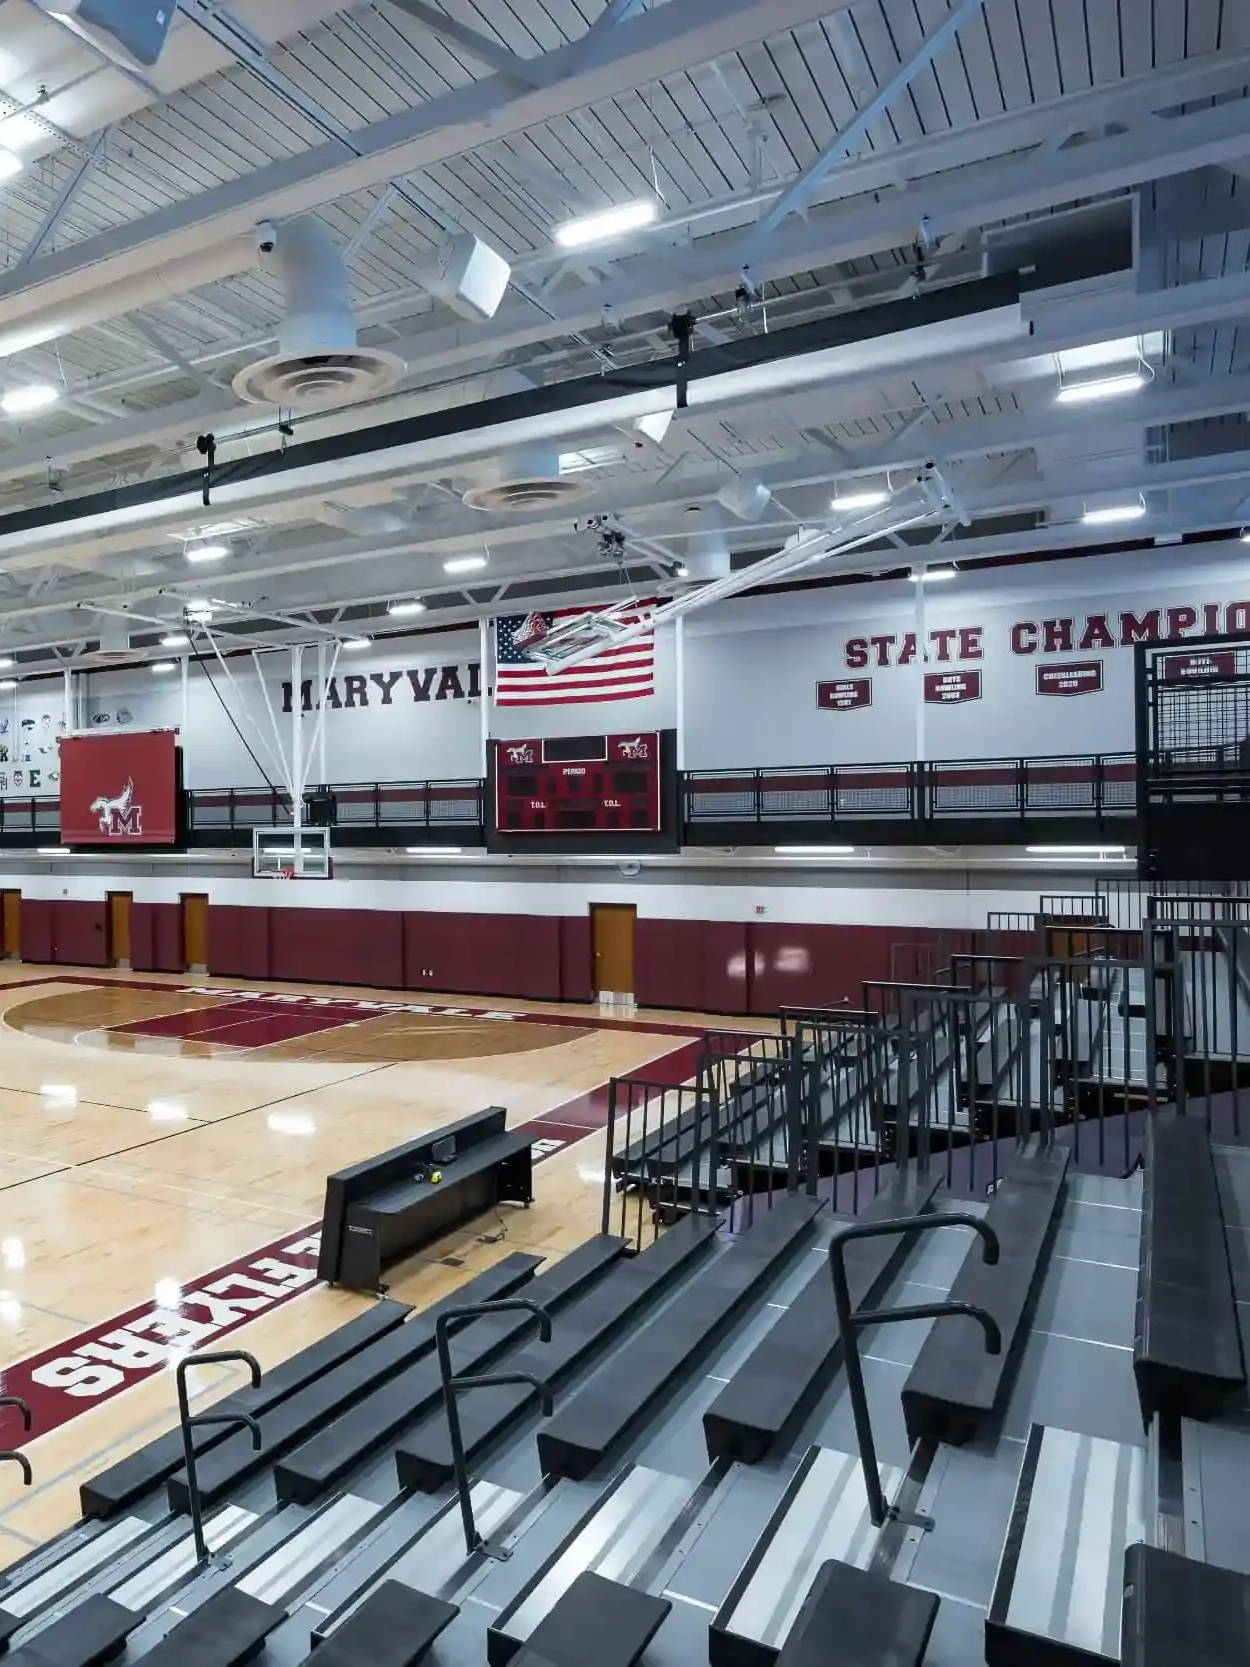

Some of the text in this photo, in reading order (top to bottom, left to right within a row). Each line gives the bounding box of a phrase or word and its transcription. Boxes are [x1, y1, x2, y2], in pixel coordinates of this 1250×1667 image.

[844, 626, 984, 670] STATE
[176, 987, 527, 1020] MARYVALE
[31, 1256, 319, 1397] FLYERS
